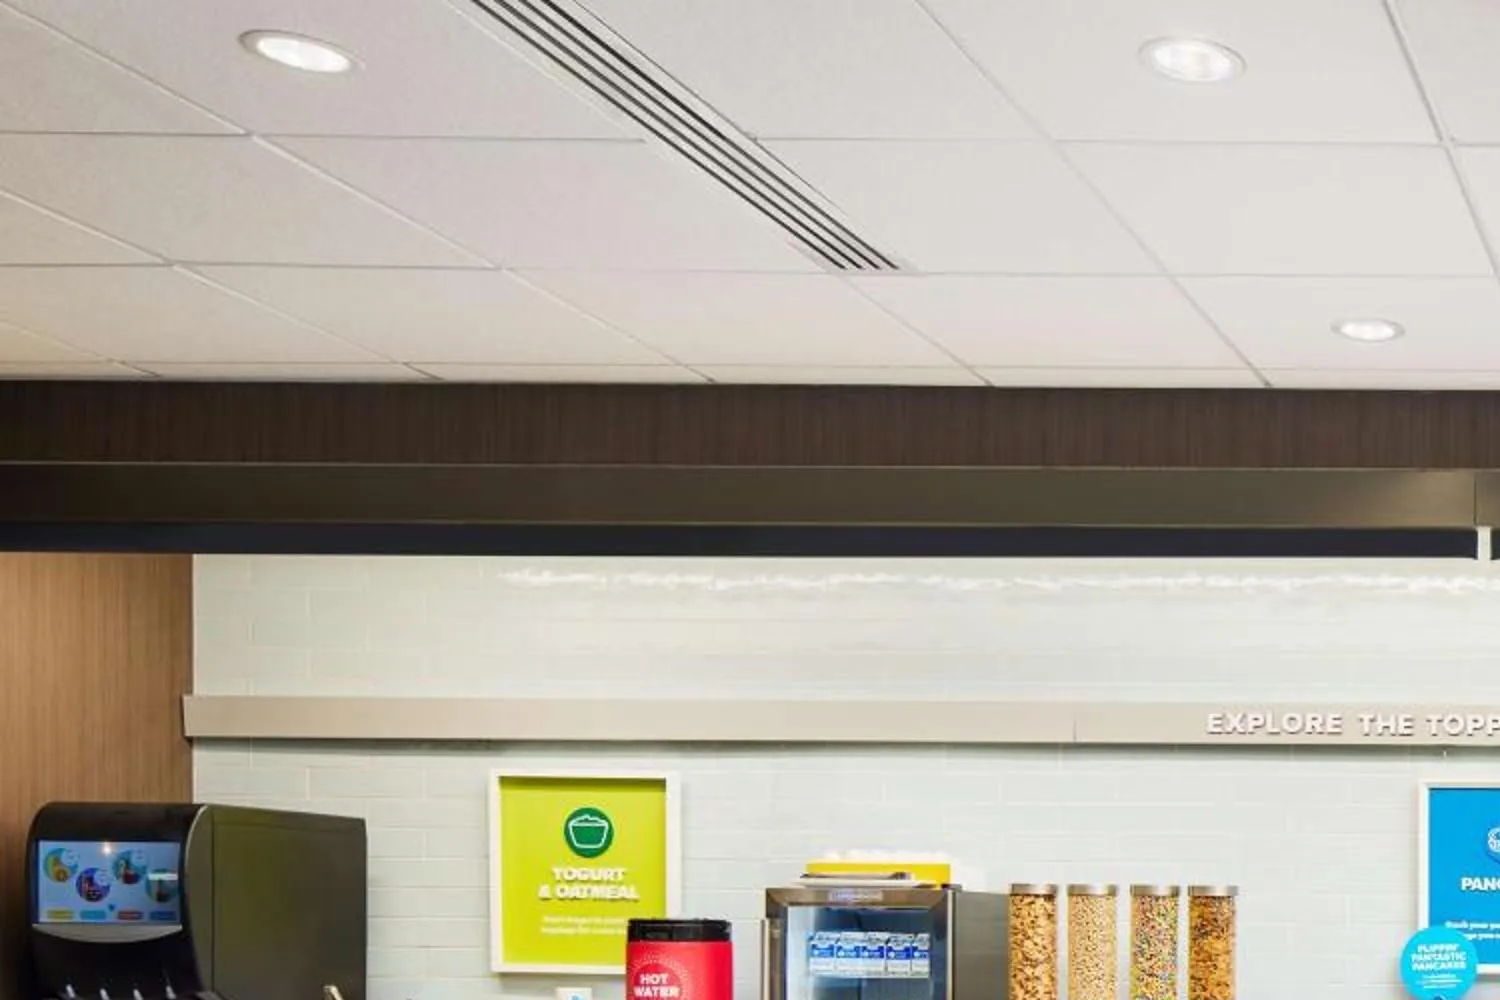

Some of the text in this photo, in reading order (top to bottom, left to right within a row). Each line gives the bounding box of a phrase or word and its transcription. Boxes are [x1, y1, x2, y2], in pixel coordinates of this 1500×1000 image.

[1206, 711, 1344, 735] EXPLORE
[1357, 713, 1415, 737] THE
[552, 867, 627, 883] YOGURT
[555, 884, 640, 901] OATMEAL
[1410, 961, 1467, 971] PANCAKES
[640, 973, 670, 985] HOT
[633, 985, 681, 998] WATER
